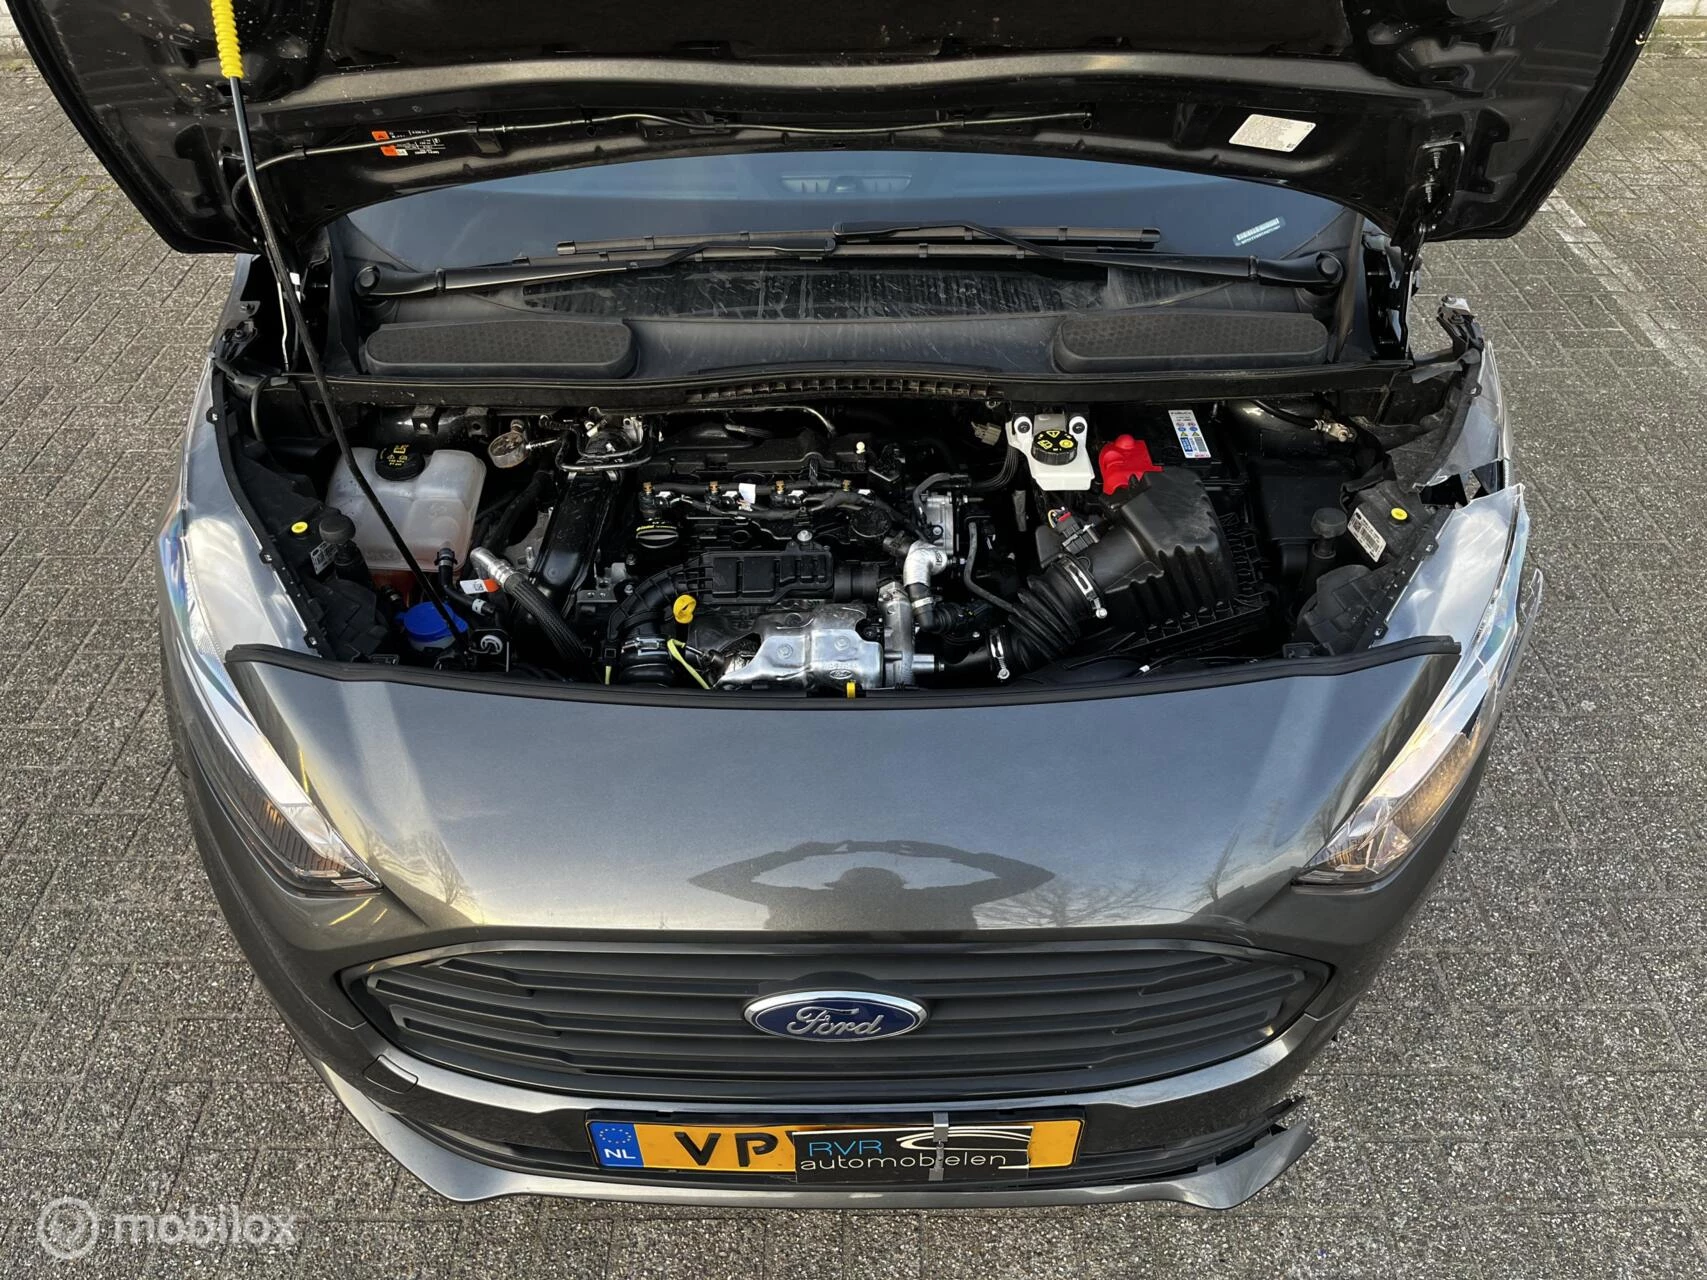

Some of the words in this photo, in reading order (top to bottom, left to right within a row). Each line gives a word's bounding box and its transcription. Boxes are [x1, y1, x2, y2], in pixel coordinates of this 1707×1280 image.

[787, 1006, 884, 1035] Ford
[603, 1148, 636, 1159] NL
[674, 1130, 798, 1167] VP
[809, 1140, 882, 1157] RVR
[800, 1151, 1006, 1170] automobelen
